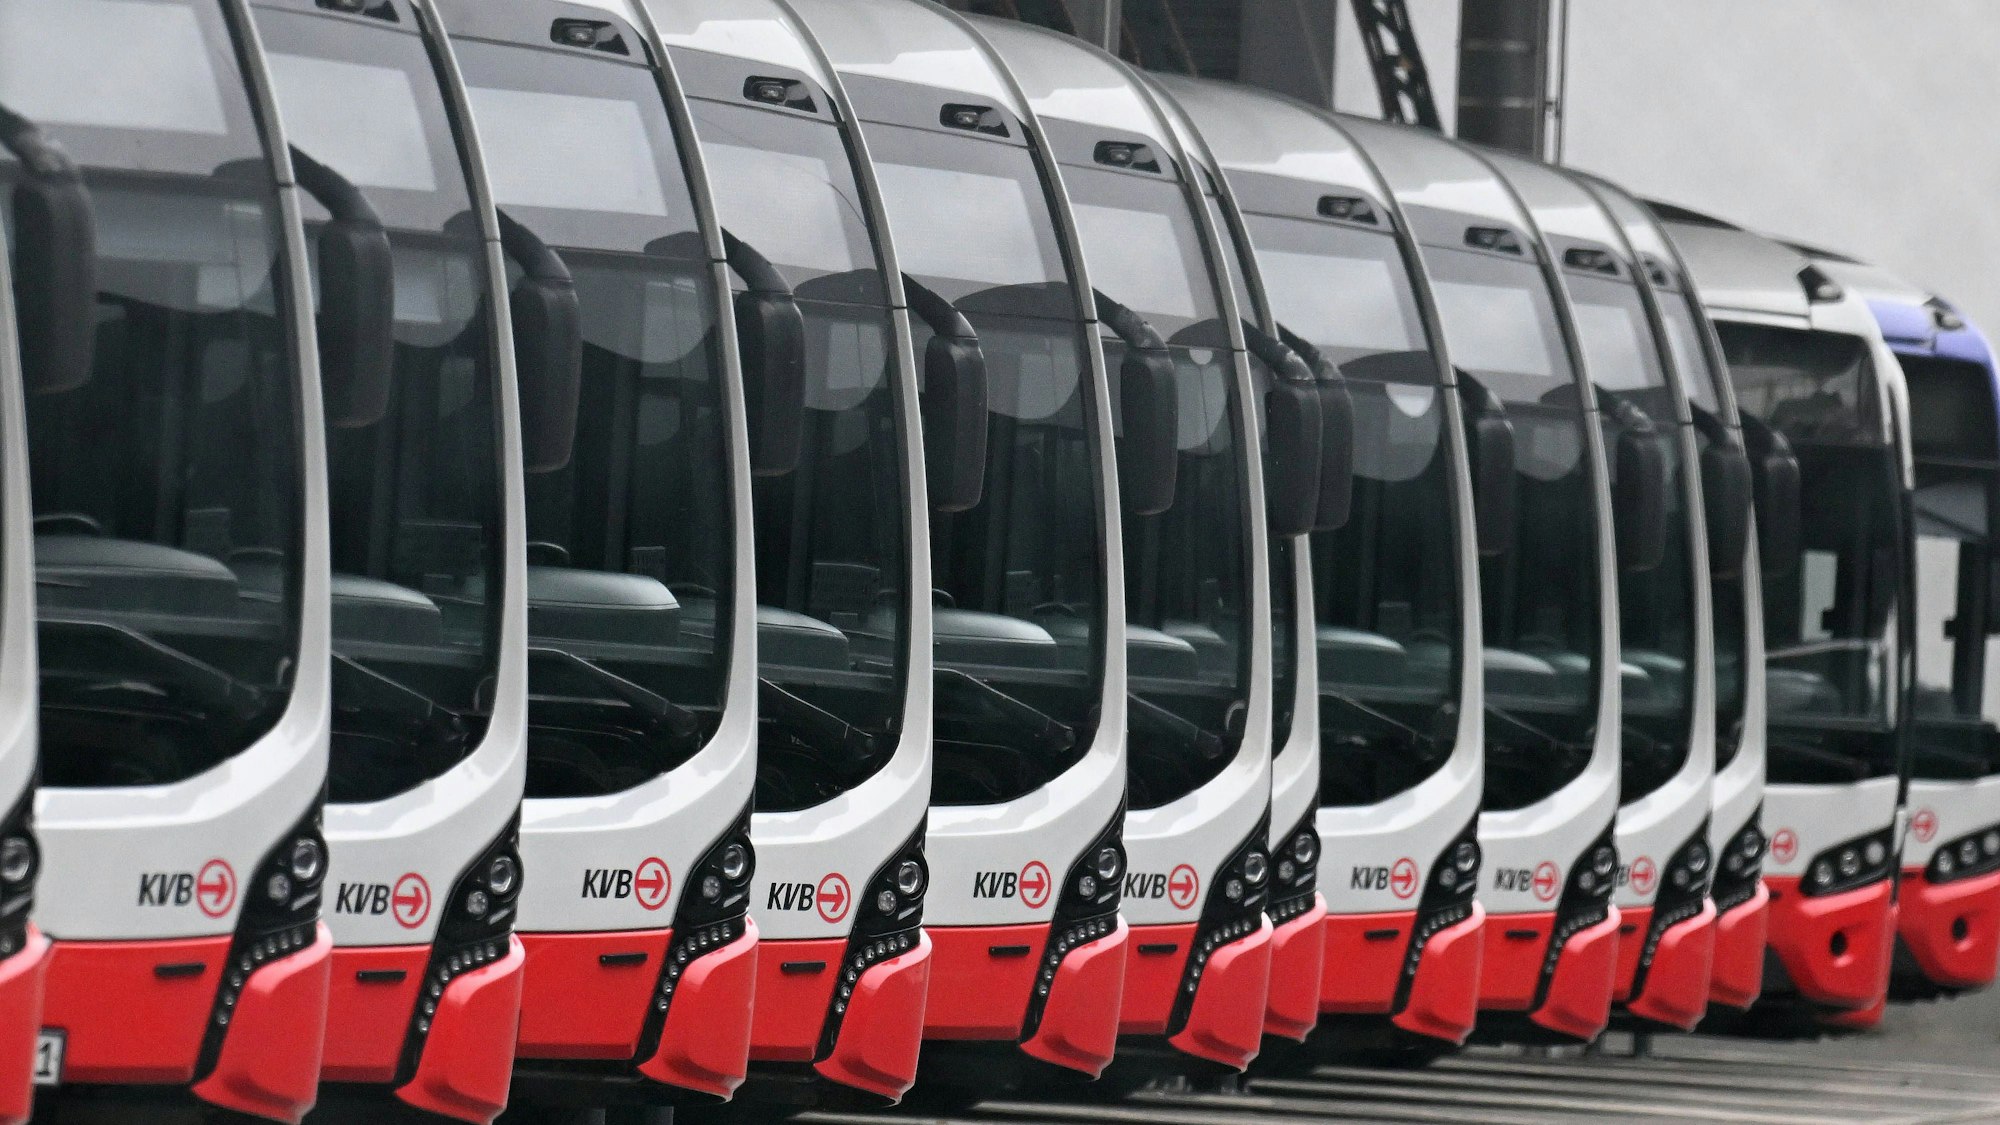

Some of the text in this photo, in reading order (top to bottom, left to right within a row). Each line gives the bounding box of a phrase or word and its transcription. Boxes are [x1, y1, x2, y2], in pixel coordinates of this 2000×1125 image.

[138, 872, 195, 907] KVB
[581, 868, 633, 899] KVB
[972, 871, 1018, 899] KVB
[1122, 872, 1167, 899] KVB
[1350, 866, 1390, 890] KVB
[1494, 867, 1532, 892] KVB
[335, 882, 389, 916] KVB
[766, 882, 815, 912] KVB
